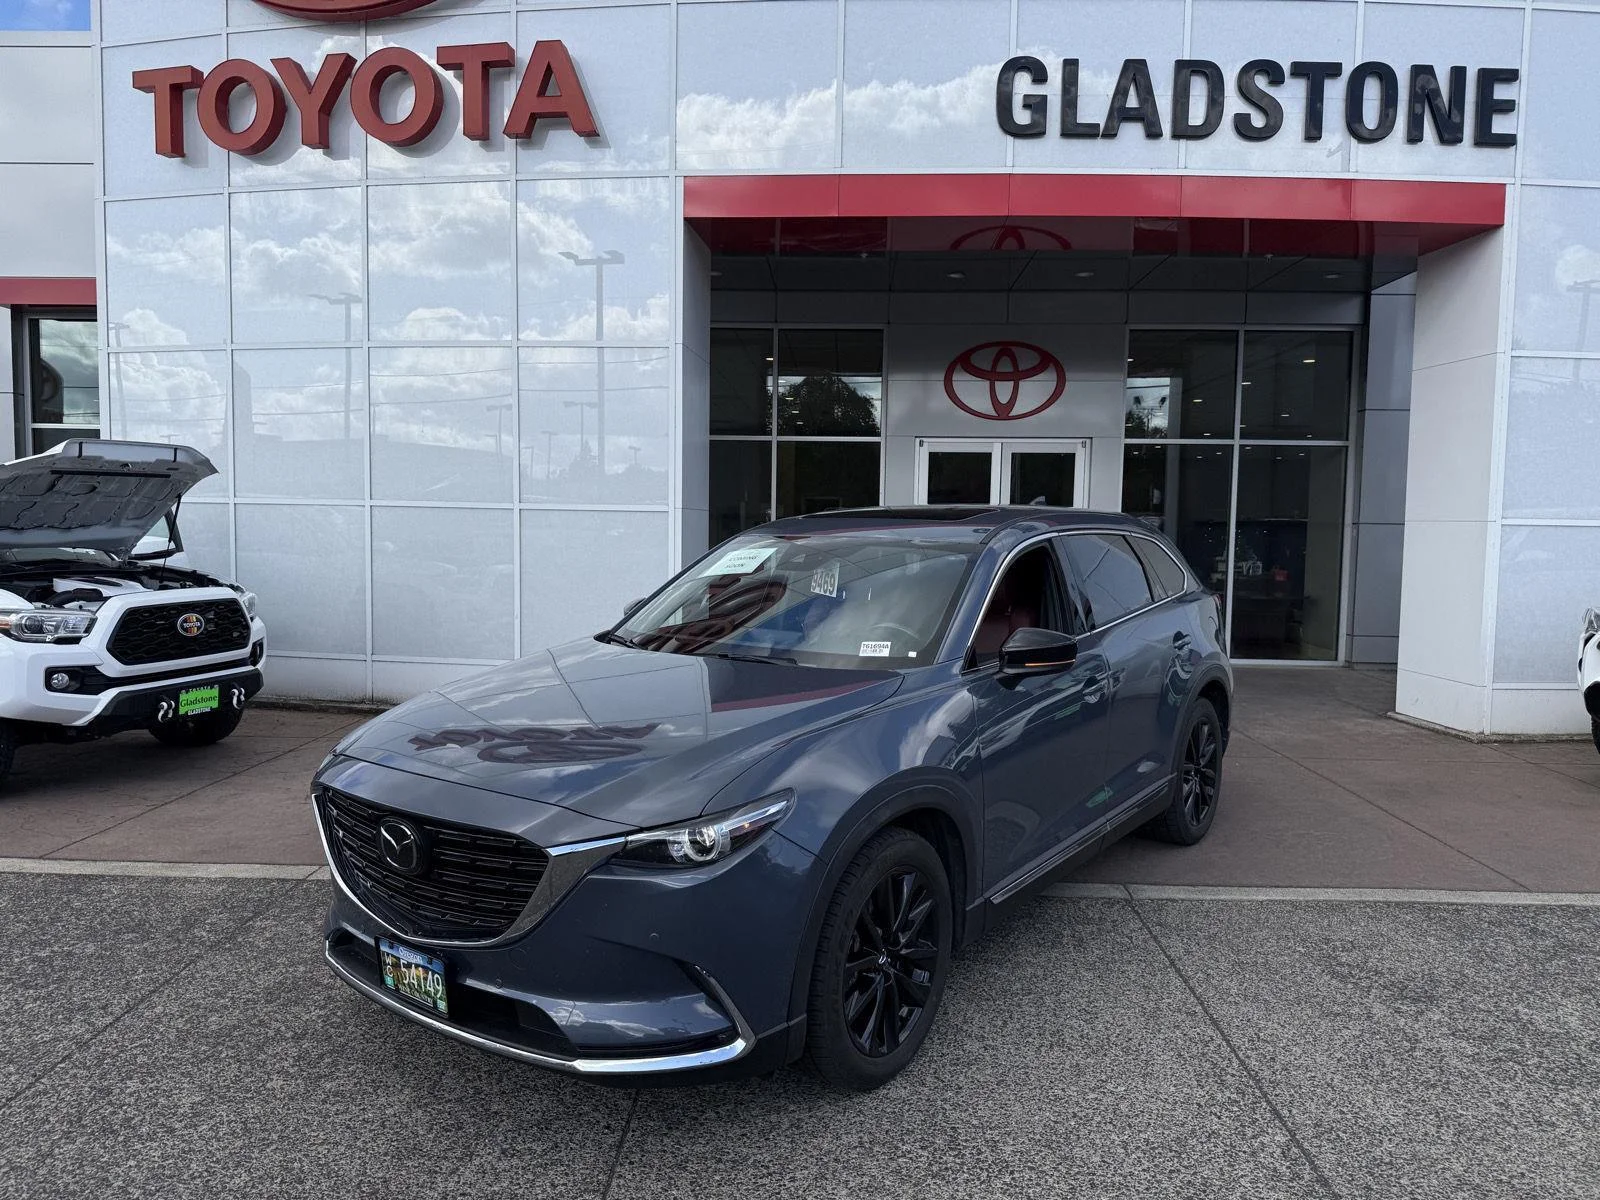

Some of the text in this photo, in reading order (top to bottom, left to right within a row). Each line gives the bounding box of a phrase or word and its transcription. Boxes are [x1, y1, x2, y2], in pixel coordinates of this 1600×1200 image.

[132, 39, 600, 158] TOYOTA
[996, 55, 1519, 147] GLADSTONE
[180, 695, 218, 707] Gladstone
[400, 959, 443, 998] 54149
